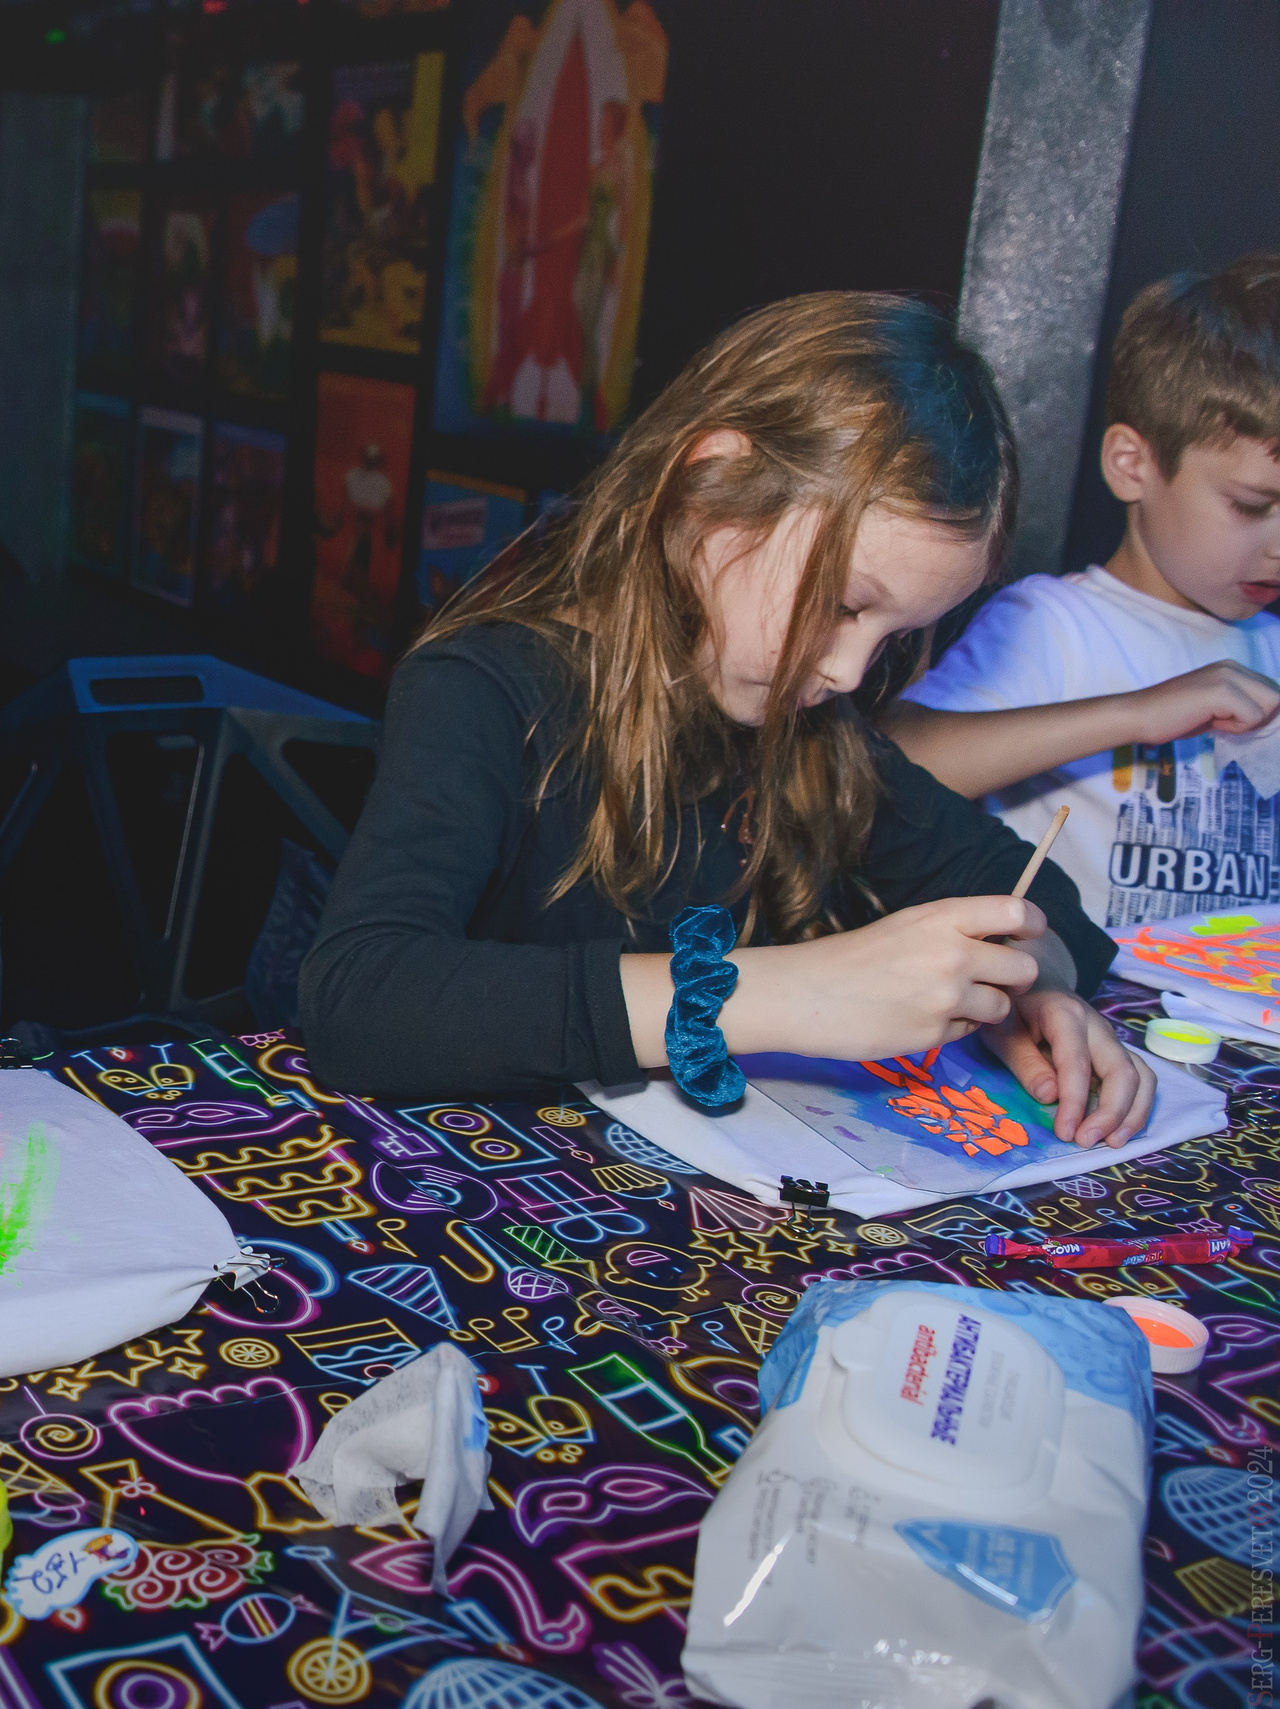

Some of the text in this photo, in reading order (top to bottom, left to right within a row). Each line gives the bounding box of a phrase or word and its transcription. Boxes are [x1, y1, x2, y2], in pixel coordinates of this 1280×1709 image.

[1109, 843, 1269, 899] URBAN
[900, 1324, 937, 1406] antibacterial
[931, 1313, 981, 1445] АНТИБАКТЕРИАЛЬНЫЕ
